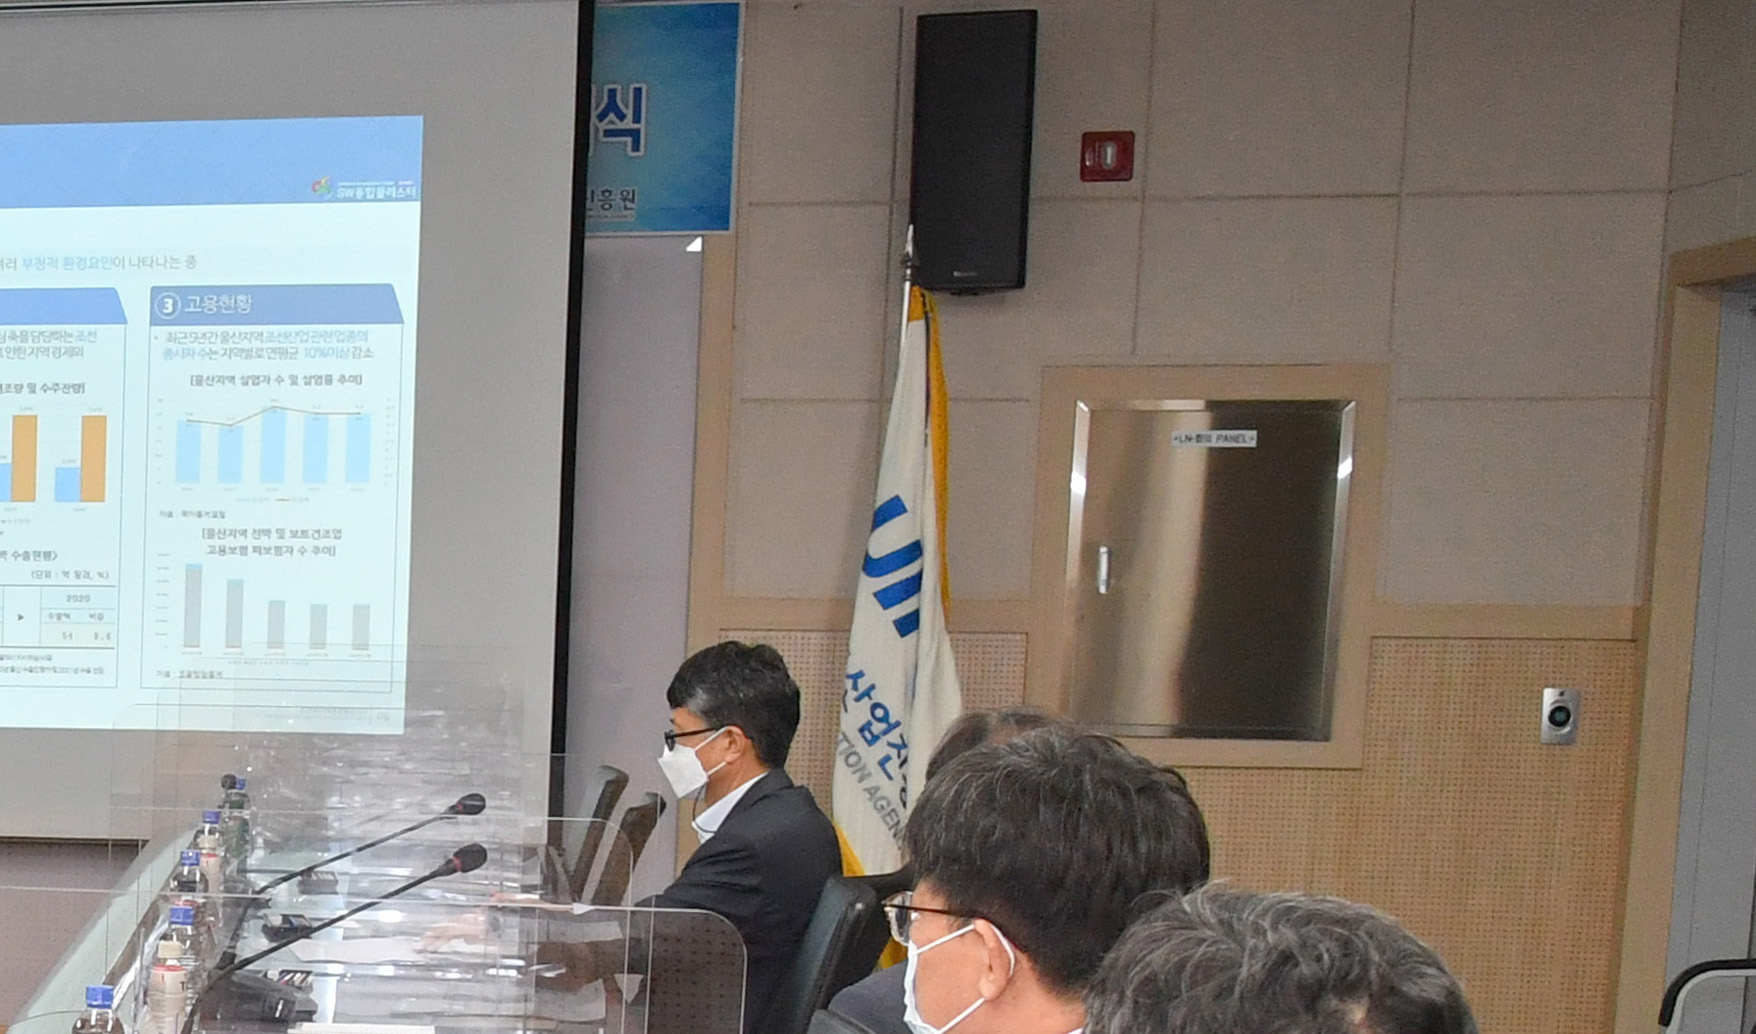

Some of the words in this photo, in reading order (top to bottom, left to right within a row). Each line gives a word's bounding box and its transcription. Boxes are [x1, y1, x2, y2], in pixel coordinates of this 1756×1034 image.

[22, 257, 60, 272] 부정적
[62, 256, 125, 272] 환경요인이
[129, 256, 181, 271] 나타나는
[185, 256, 197, 271] 중
[184, 295, 253, 314] 고용현황
[862, 494, 923, 638] UI
